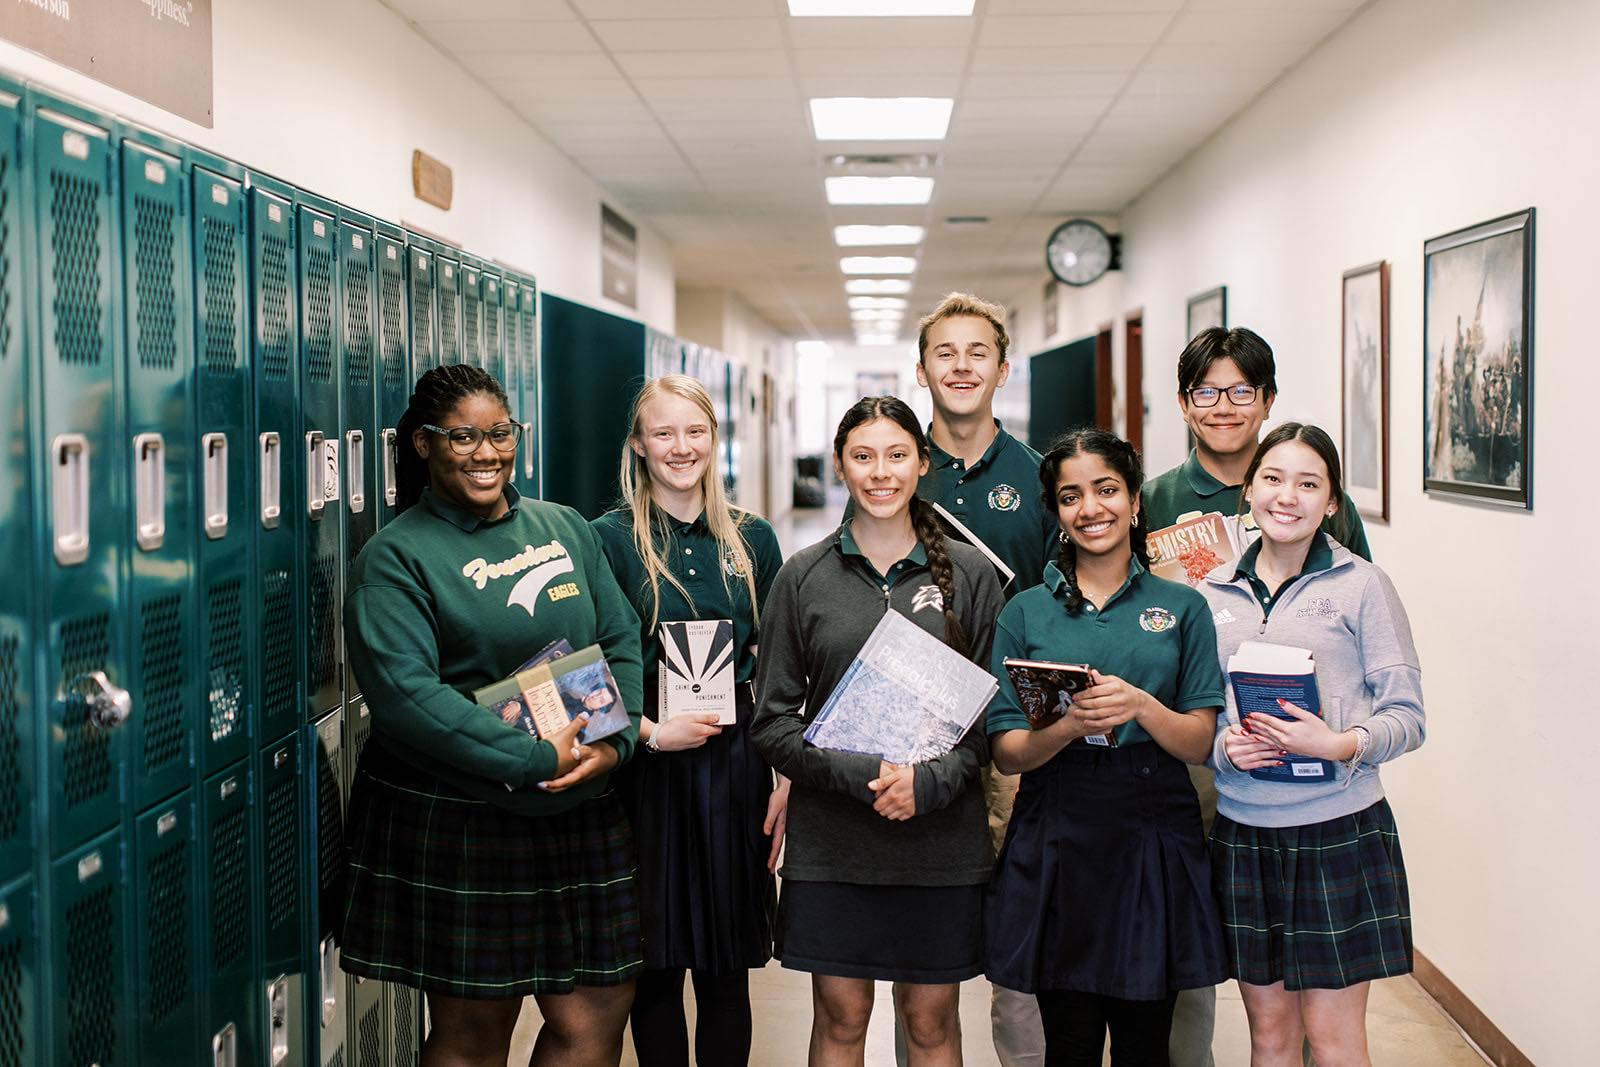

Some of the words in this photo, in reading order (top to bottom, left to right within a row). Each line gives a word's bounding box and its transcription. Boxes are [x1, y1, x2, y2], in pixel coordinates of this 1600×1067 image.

[141, 0, 192, 27] ppiness.”
[547, 583, 580, 602] EAGLES
[878, 645, 960, 710] Precalculus
